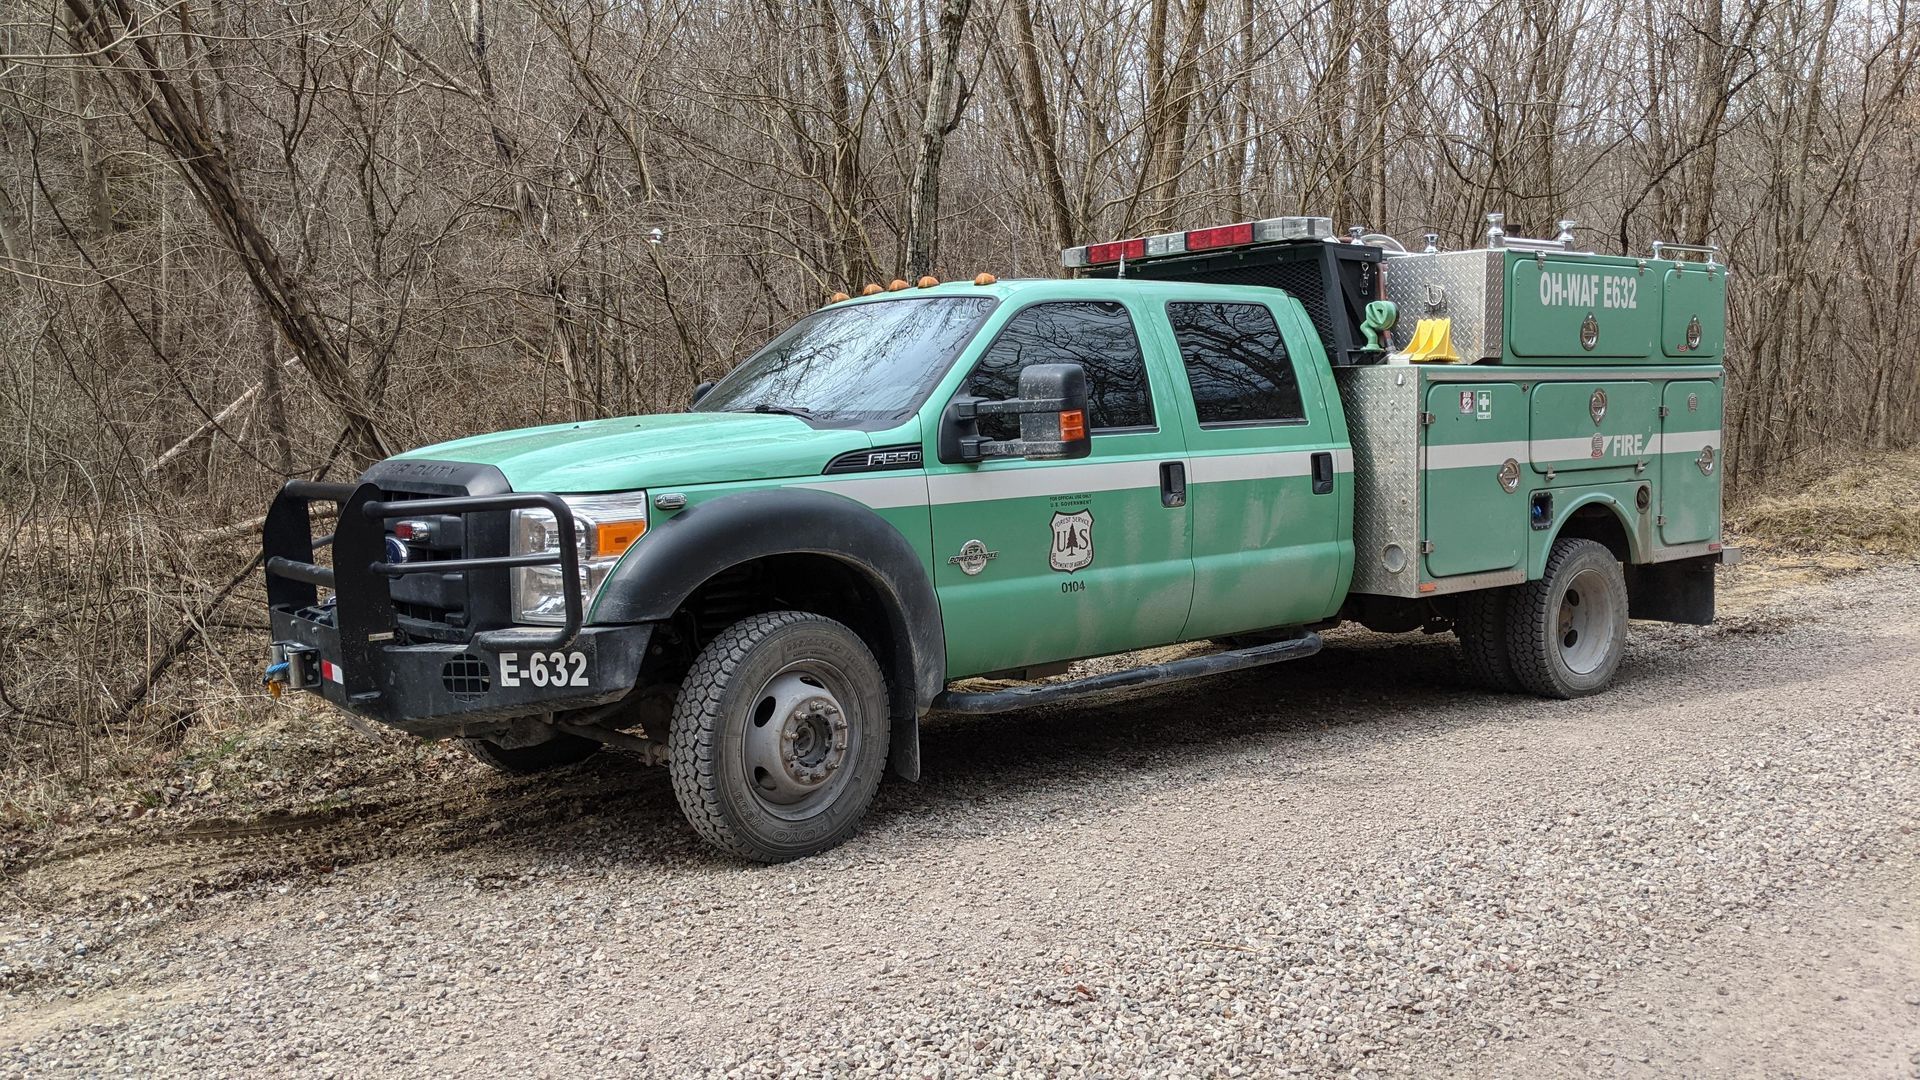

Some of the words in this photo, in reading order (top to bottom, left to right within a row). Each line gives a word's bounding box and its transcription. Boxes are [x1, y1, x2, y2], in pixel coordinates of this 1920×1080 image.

[1540, 272, 1600, 307] OH-WAF
[1603, 275, 1637, 309] E632
[1613, 434, 1643, 457] FIRE
[1055, 516, 1072, 530] FOREST
[1072, 516, 1090, 528] SERVICE
[1061, 581, 1085, 593] 0104
[499, 651, 590, 687] E-632
